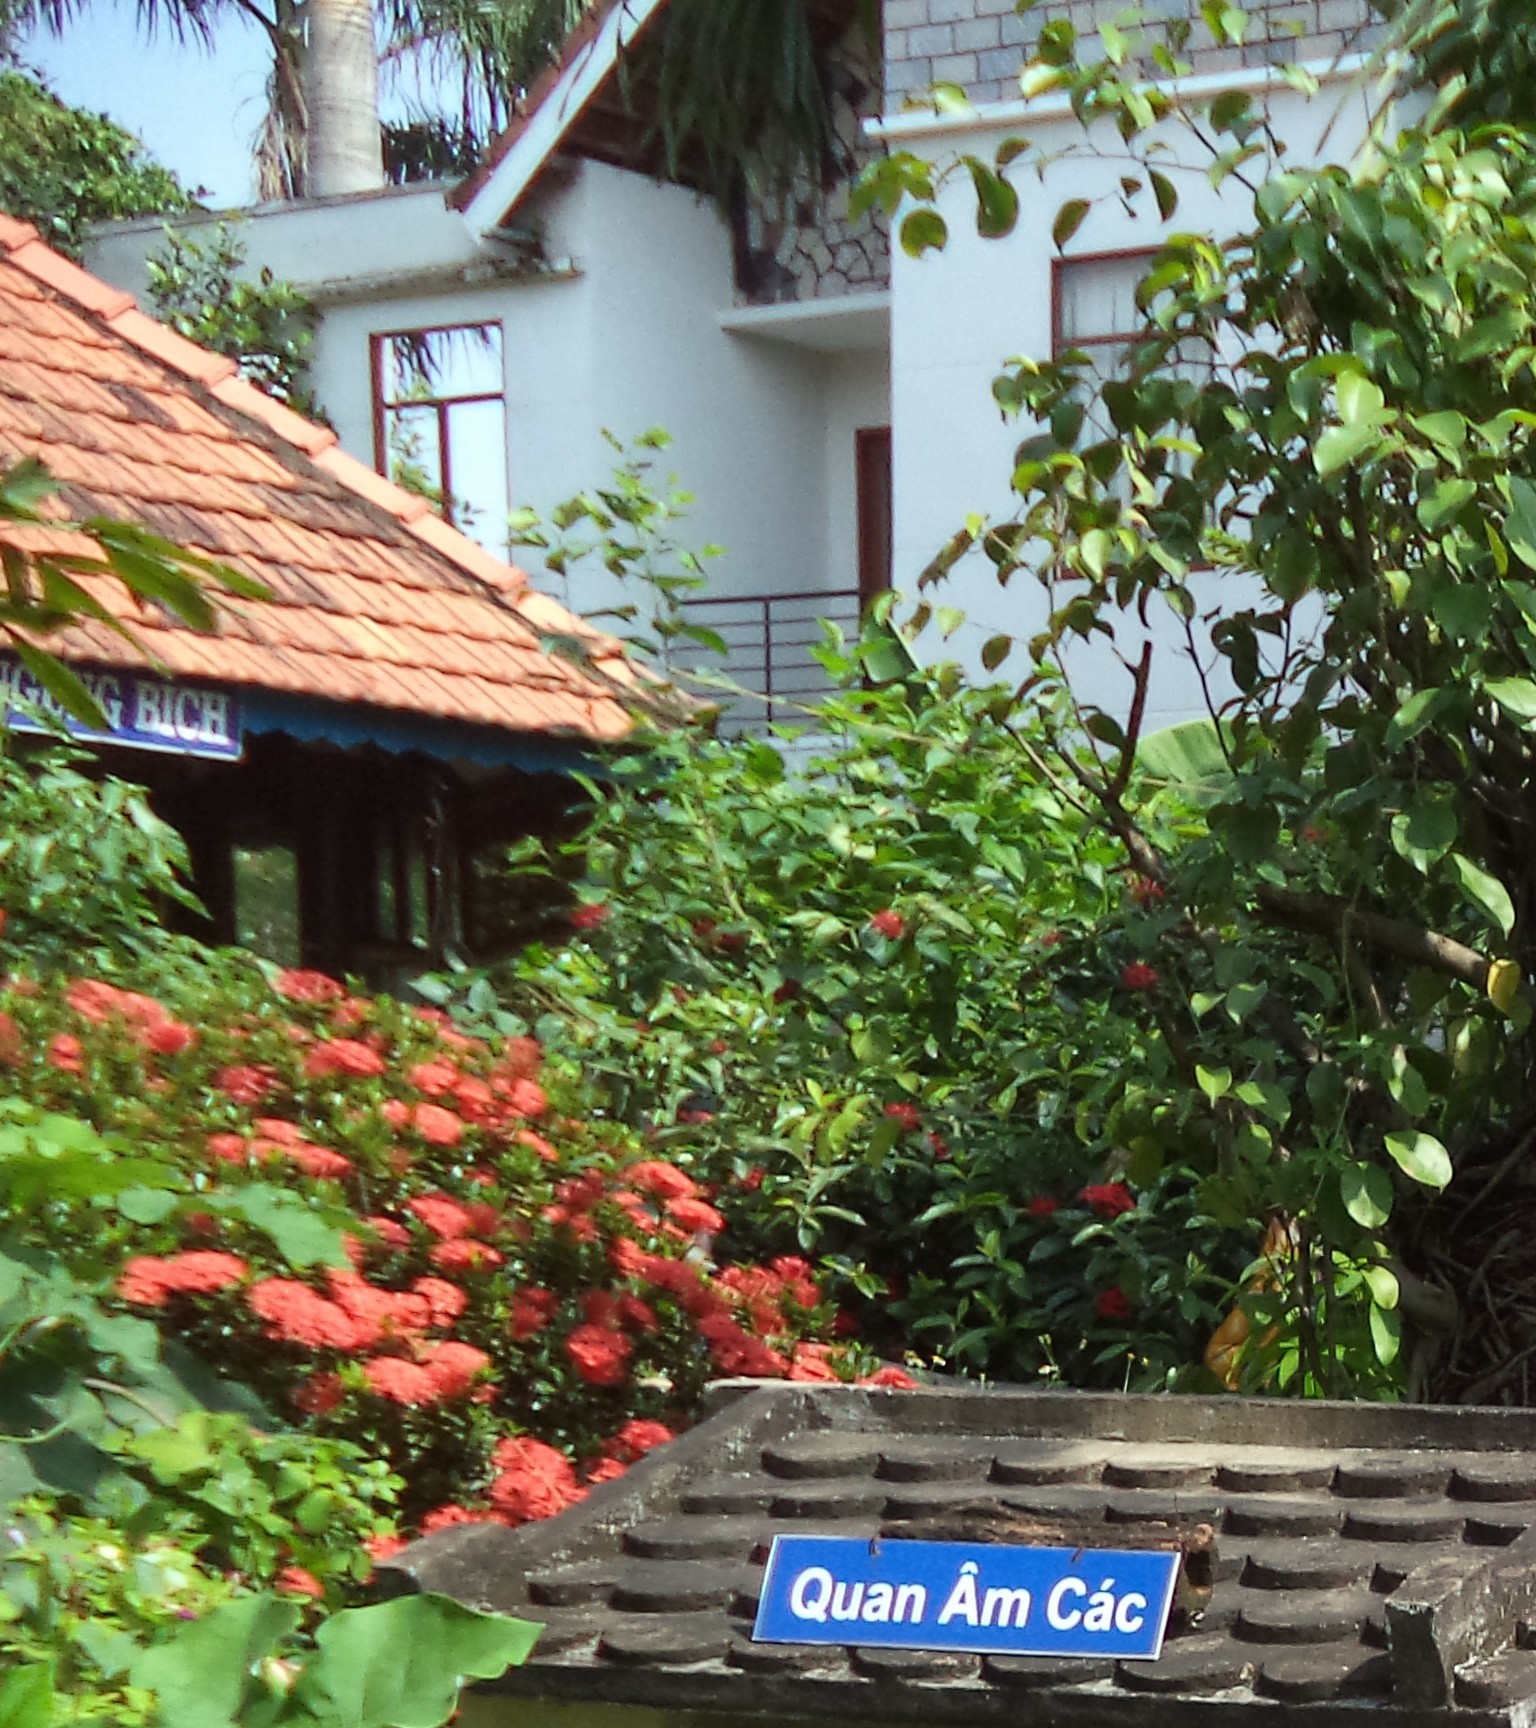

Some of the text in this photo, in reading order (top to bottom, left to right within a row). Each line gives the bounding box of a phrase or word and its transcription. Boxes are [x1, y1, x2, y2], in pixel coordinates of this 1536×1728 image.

[789, 1560, 1148, 1634] Quan Âm Các
